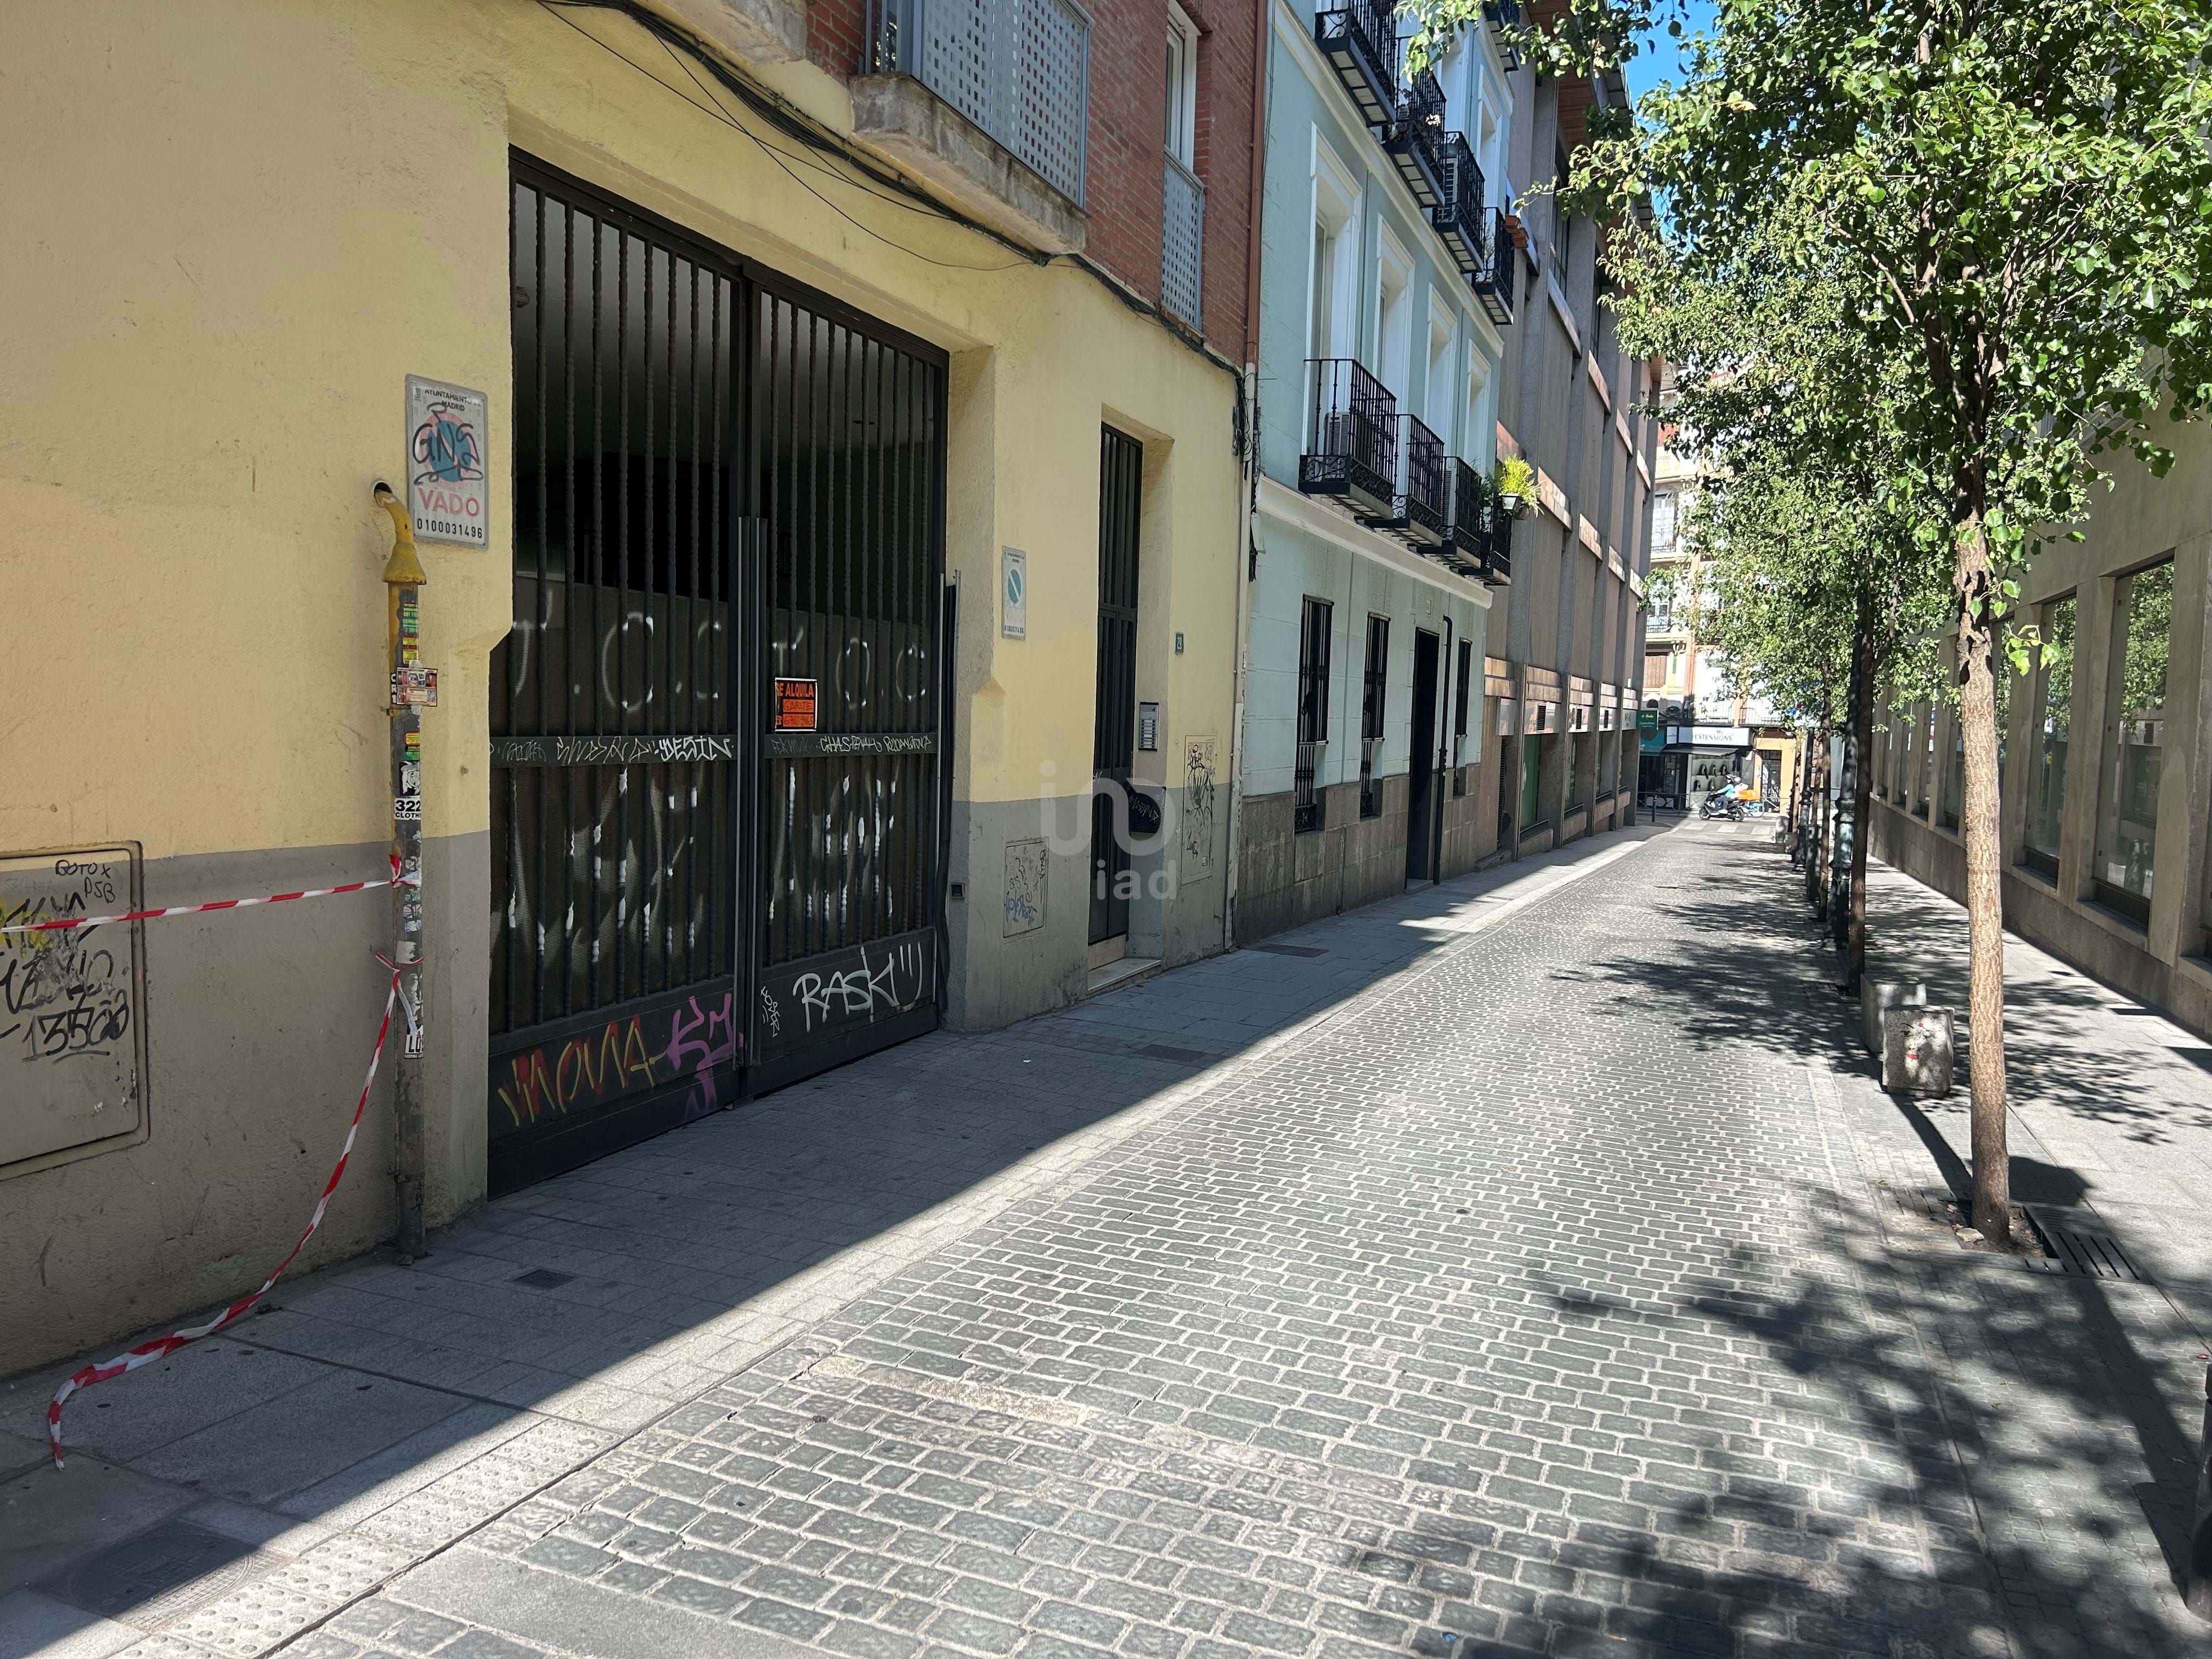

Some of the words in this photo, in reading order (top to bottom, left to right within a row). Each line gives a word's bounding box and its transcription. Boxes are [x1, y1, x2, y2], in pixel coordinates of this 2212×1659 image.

[442, 400, 465, 412] MADRID
[419, 488, 480, 517] VADO
[417, 518, 483, 539] 0100031496
[776, 682, 783, 696] SE
[785, 682, 814, 698] ALQUILA
[395, 800, 421, 811] 322
